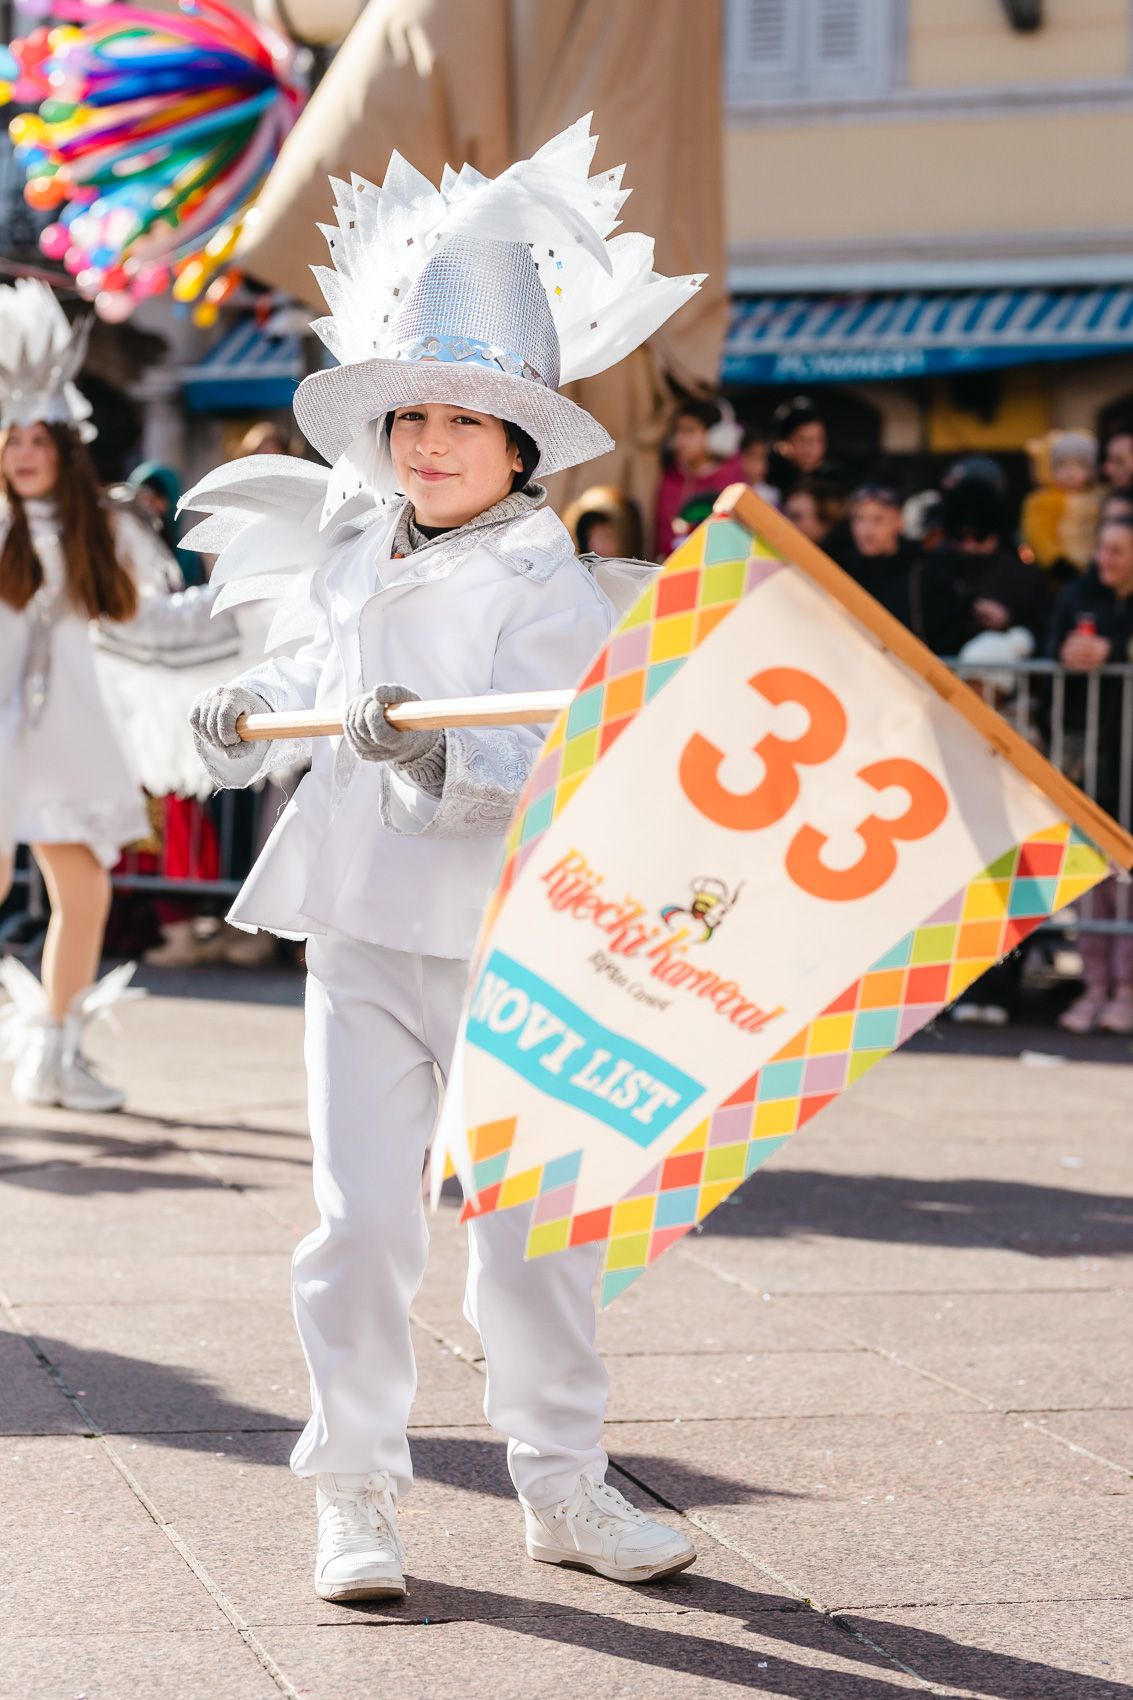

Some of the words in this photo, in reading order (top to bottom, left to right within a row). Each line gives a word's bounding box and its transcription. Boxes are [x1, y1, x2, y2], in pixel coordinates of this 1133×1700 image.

[679, 667, 949, 902] 33
[471, 970, 587, 1075] NOVI
[569, 1047, 682, 1125] LIST
